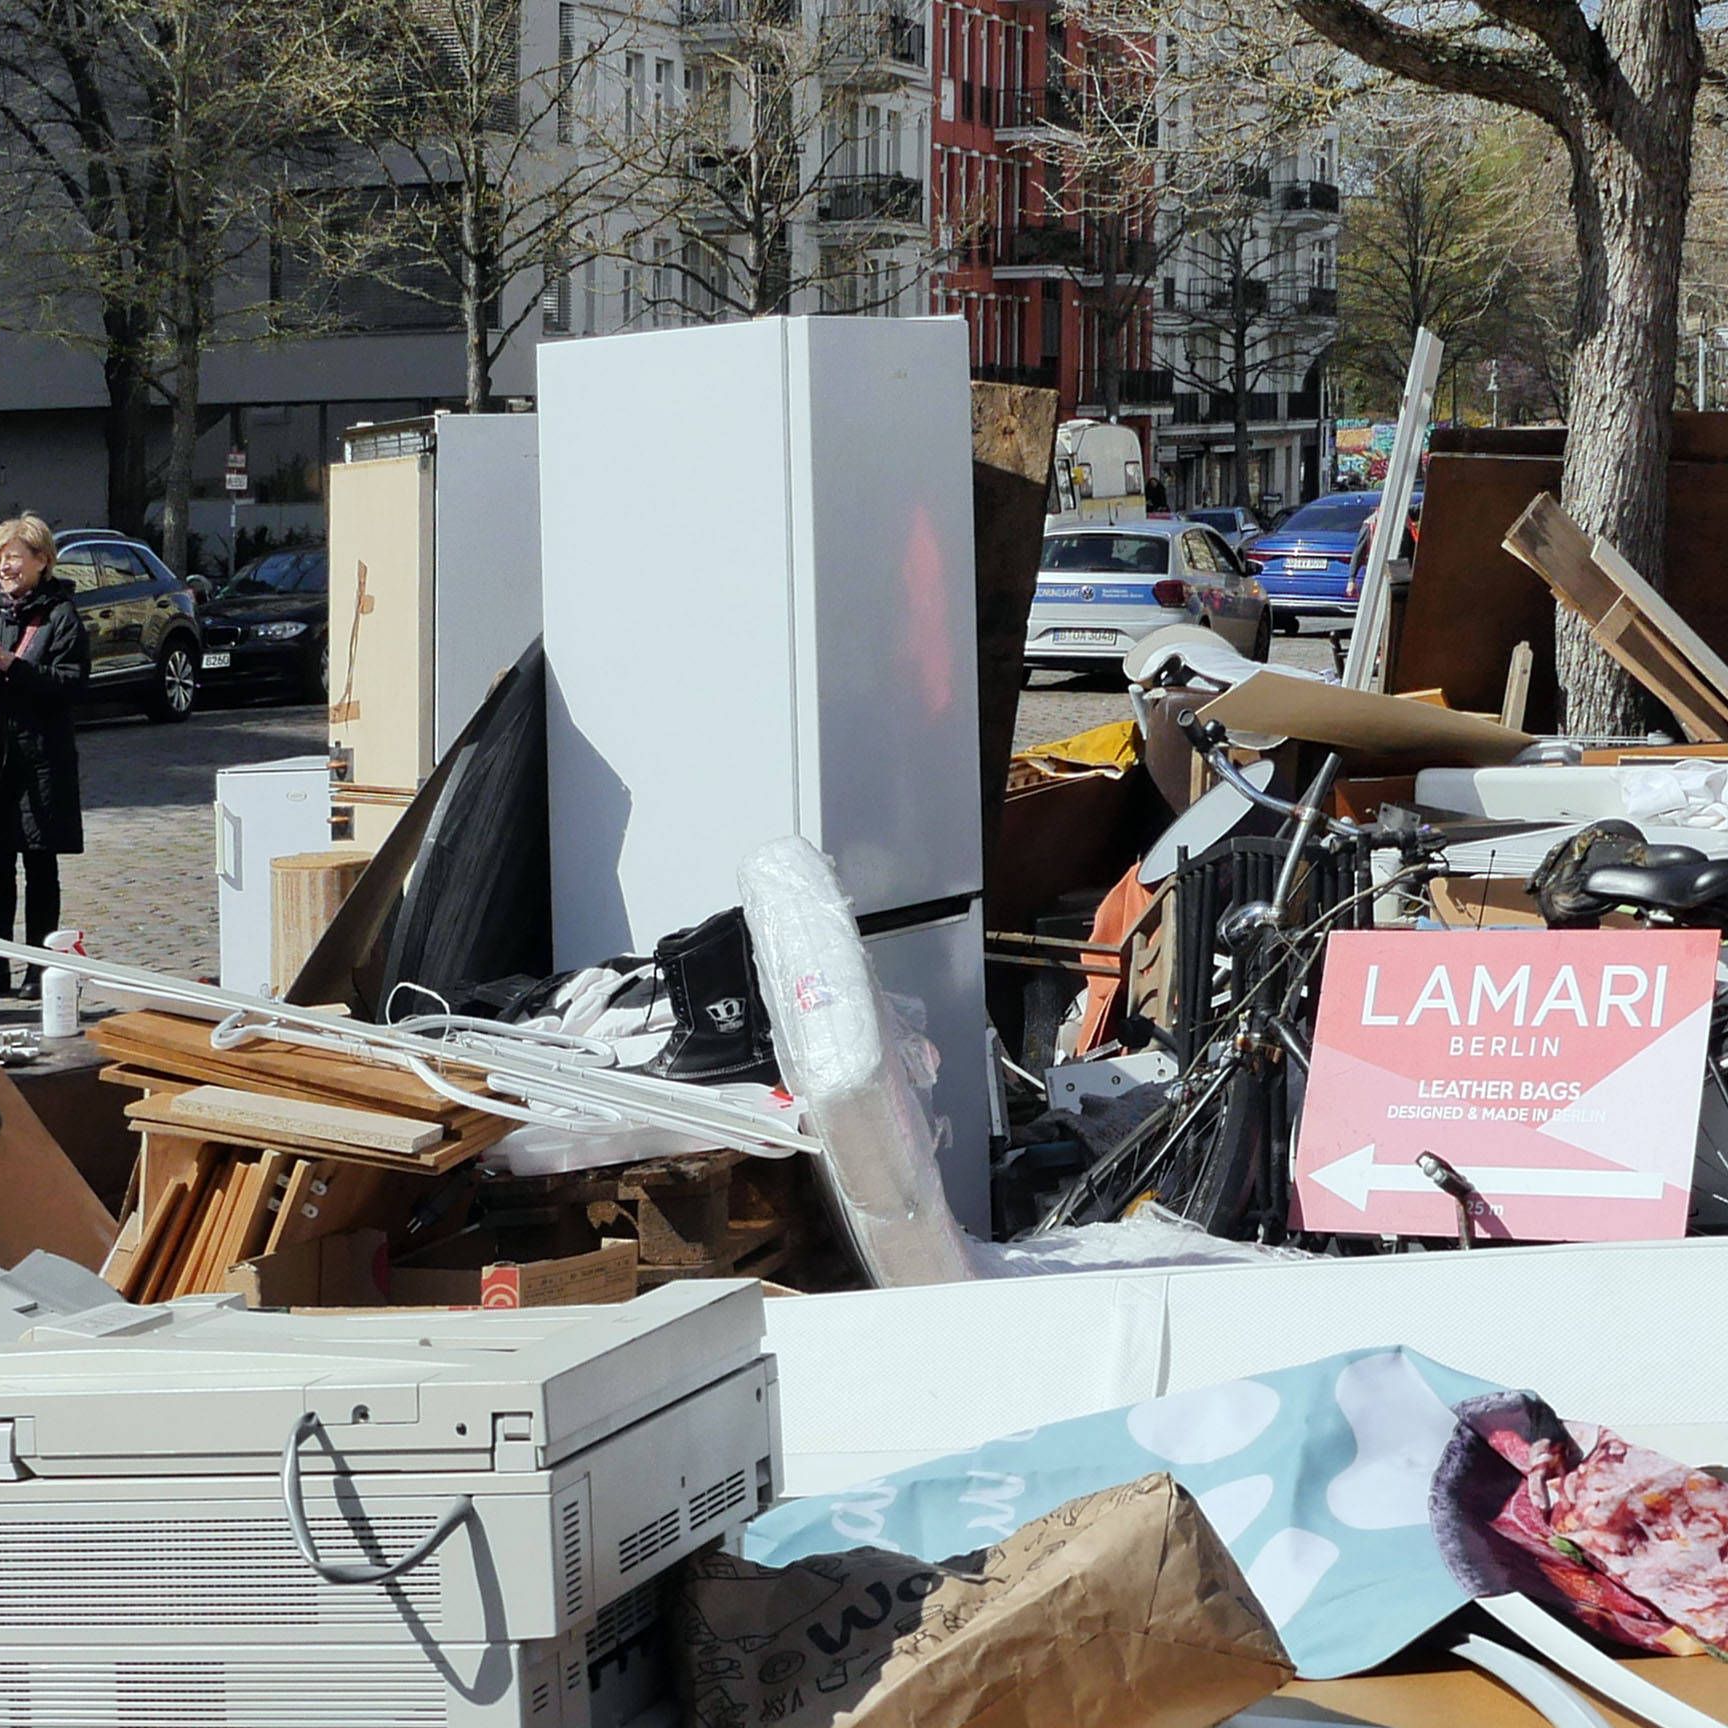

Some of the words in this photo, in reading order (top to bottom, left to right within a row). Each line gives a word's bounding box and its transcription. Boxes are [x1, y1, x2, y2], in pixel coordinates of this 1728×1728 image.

[1360, 964, 1668, 1028] LAMARI
[1449, 1036, 1561, 1057] BERLIN
[1418, 1080, 1513, 1100] LEATHER
[1520, 1081, 1581, 1101] BAGS
[1387, 1105, 1462, 1120] DESIGNED
[1467, 1107, 1477, 1120] &
[1481, 1107, 1527, 1121] MADE
[1532, 1108, 1549, 1122] IN
[1552, 1109, 1607, 1123] BERLIN
[1488, 1203, 1504, 1216] m
